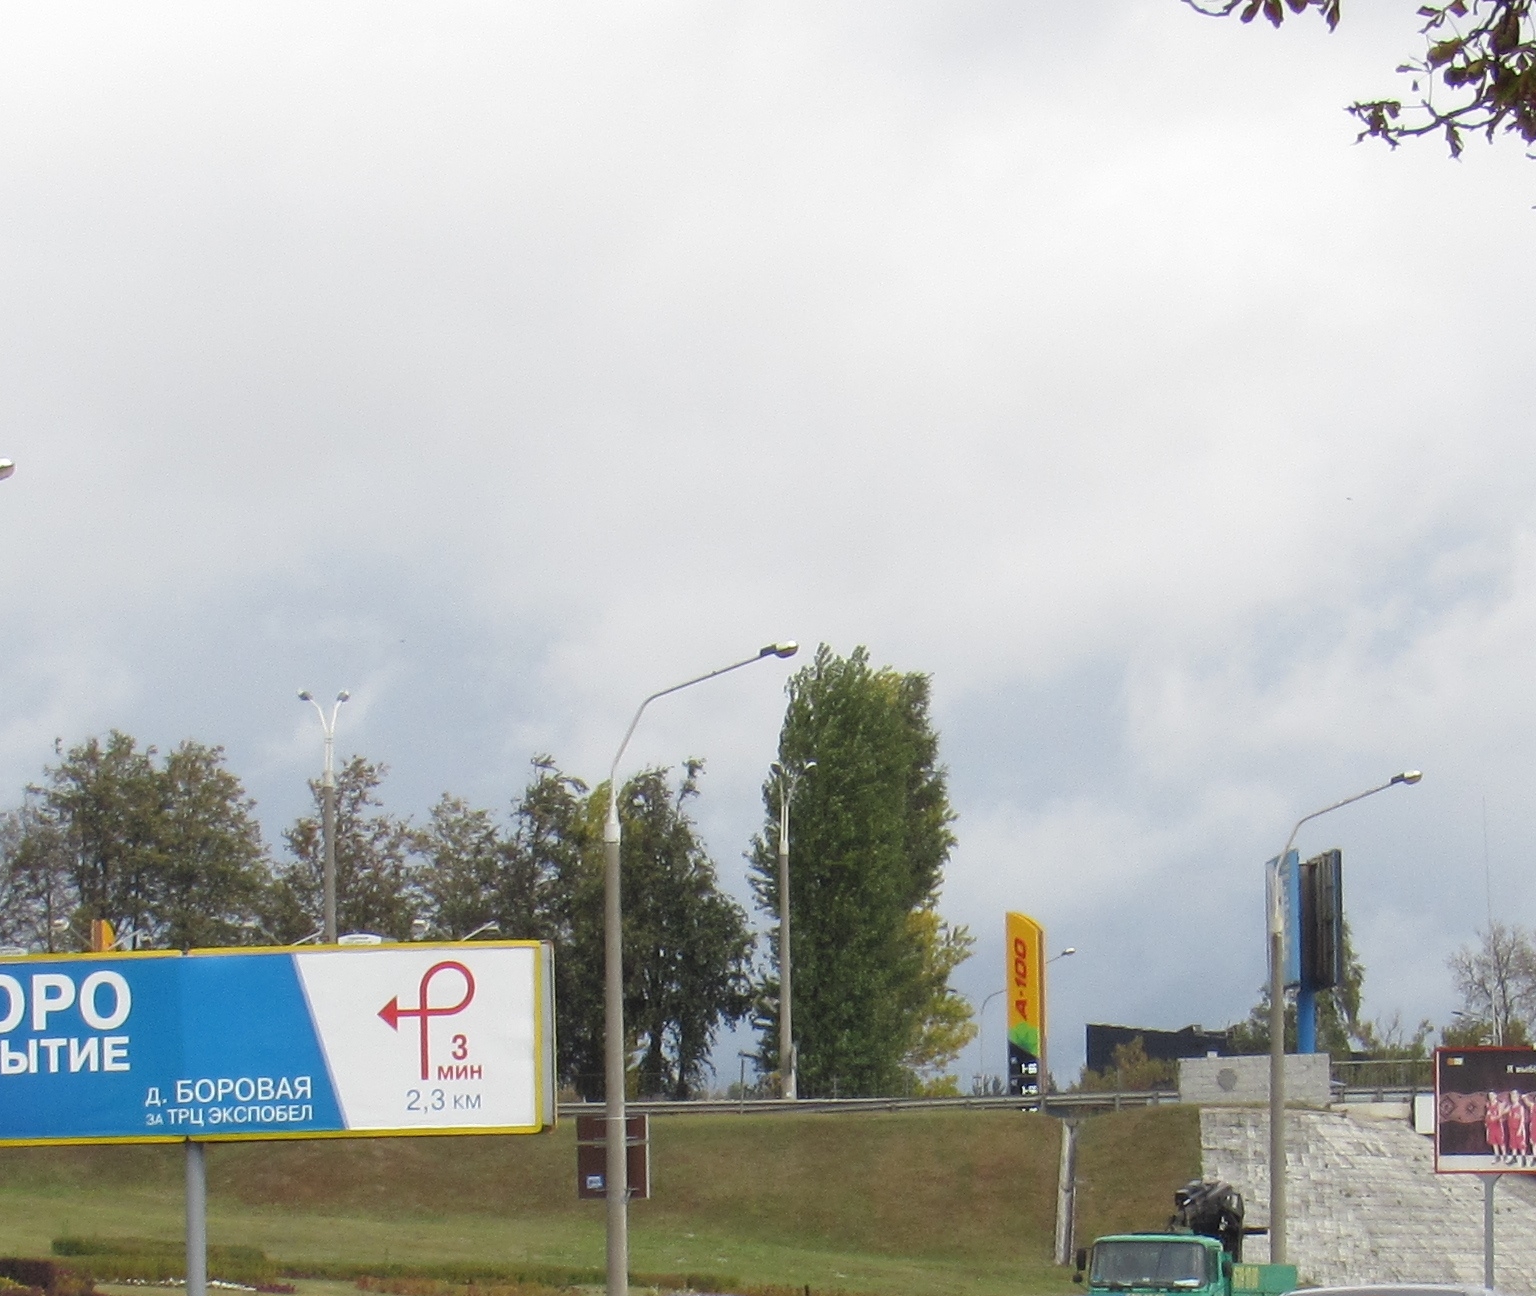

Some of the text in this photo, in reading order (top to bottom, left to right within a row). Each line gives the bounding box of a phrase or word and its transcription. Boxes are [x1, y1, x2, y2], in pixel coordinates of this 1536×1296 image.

[451, 1033, 468, 1061] 3
[176, 1075, 313, 1105] БОРОВАЯ
[406, 1089, 446, 1115] 2,3
[167, 1108, 205, 1127] ТРЦ
[208, 1104, 313, 1125] ЭКСПОБЕЛ
